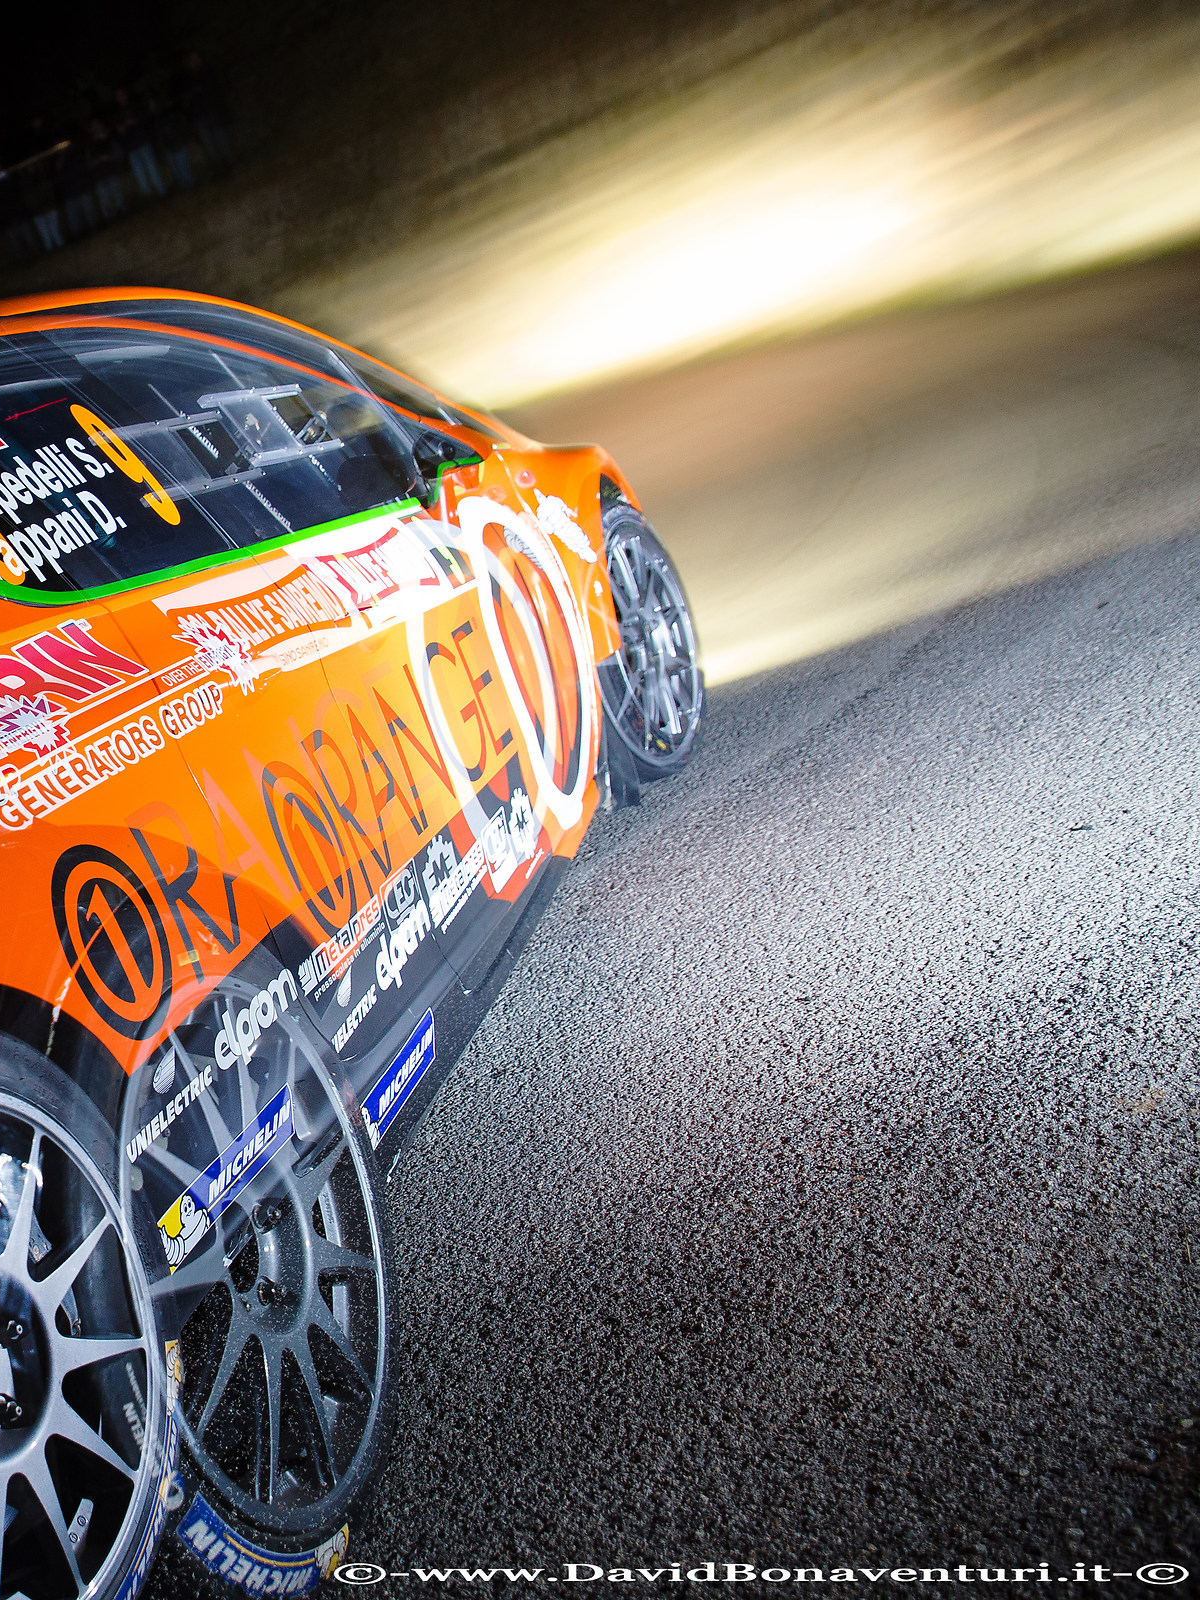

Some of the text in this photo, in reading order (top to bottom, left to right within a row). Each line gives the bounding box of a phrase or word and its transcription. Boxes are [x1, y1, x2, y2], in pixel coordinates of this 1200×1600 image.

[65, 438, 115, 478] S.
[70, 404, 181, 525] 9
[76, 491, 128, 534] D.
[159, 681, 224, 737] GROUP
[181, 661, 203, 679] THE
[378, 1023, 434, 1118] MICHELIN
[126, 1065, 214, 1164] UNIELECTRIC
[207, 1103, 292, 1204] MICHELIN
[184, 1517, 315, 1597] MICHELIN
